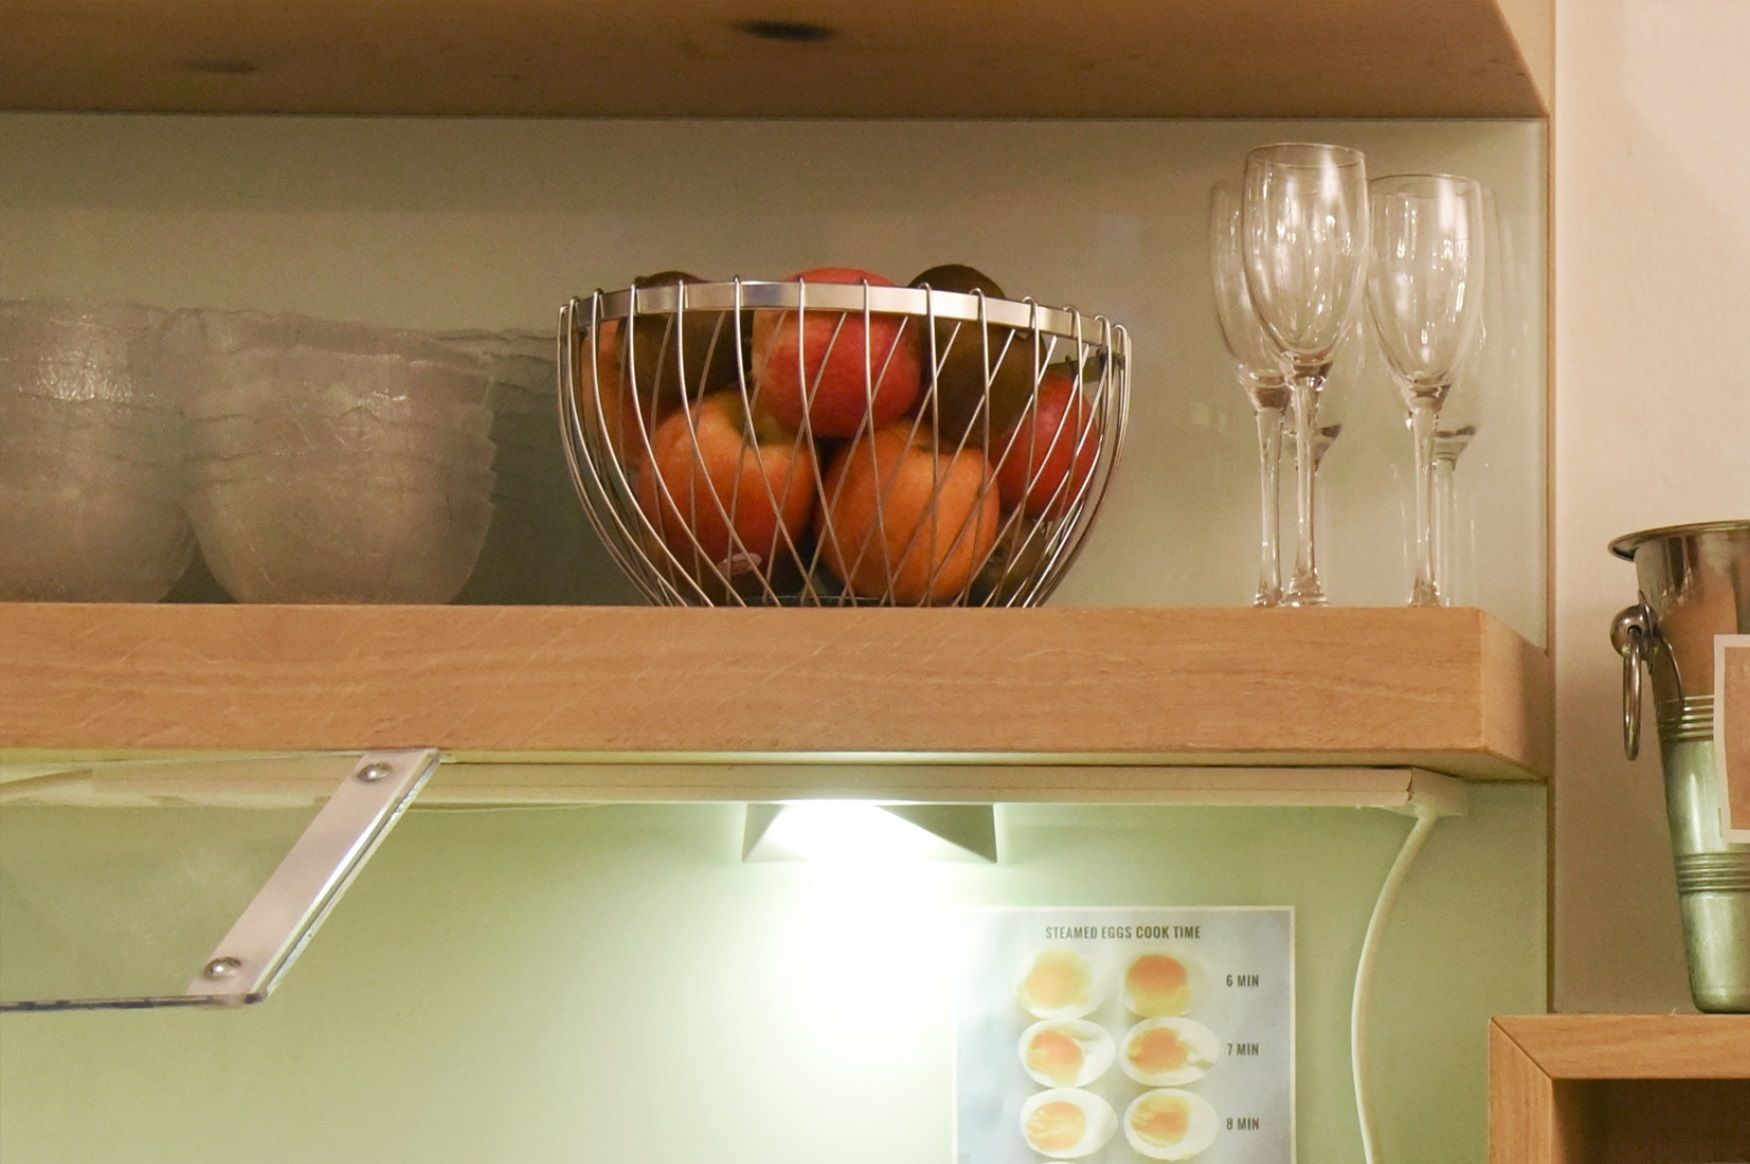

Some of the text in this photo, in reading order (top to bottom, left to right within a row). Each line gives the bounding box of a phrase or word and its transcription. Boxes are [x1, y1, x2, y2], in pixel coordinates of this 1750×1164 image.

[1045, 924, 1201, 939] STEAMED EGGS COOK TIME
[1226, 974, 1260, 988] 6 MIN
[1226, 1043, 1260, 1057] 7 MIN
[1226, 1117, 1260, 1131] 8 MIN
